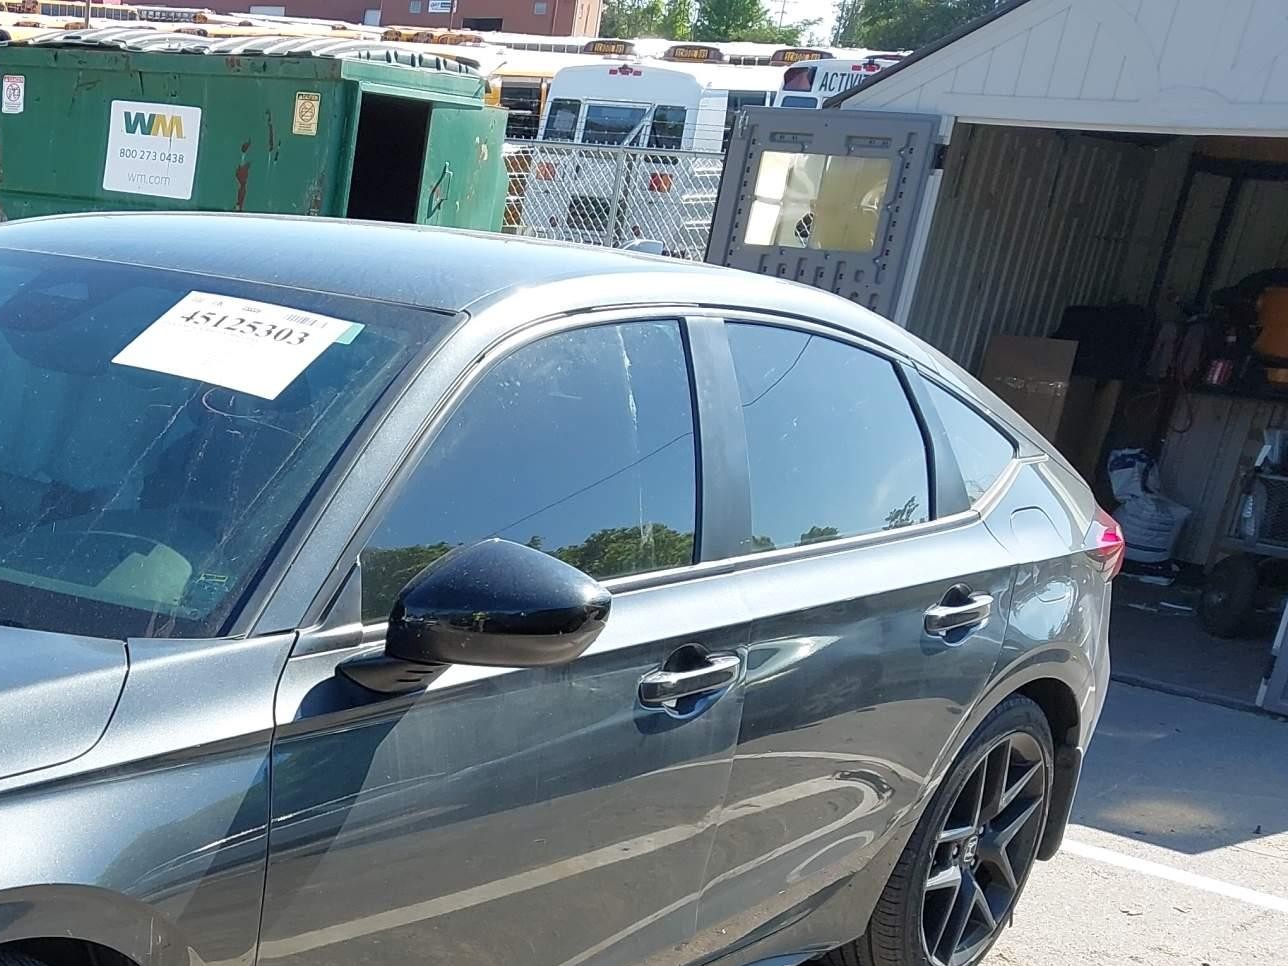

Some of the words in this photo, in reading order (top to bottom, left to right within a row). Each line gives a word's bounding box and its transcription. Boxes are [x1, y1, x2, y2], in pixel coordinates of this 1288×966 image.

[124, 111, 184, 139] WM
[119, 147, 138, 159] 800
[139, 150, 157, 161] 273
[159, 152, 185, 164] 0438
[127, 172, 171, 186] wm.com
[180, 310, 310, 346] 45125303
